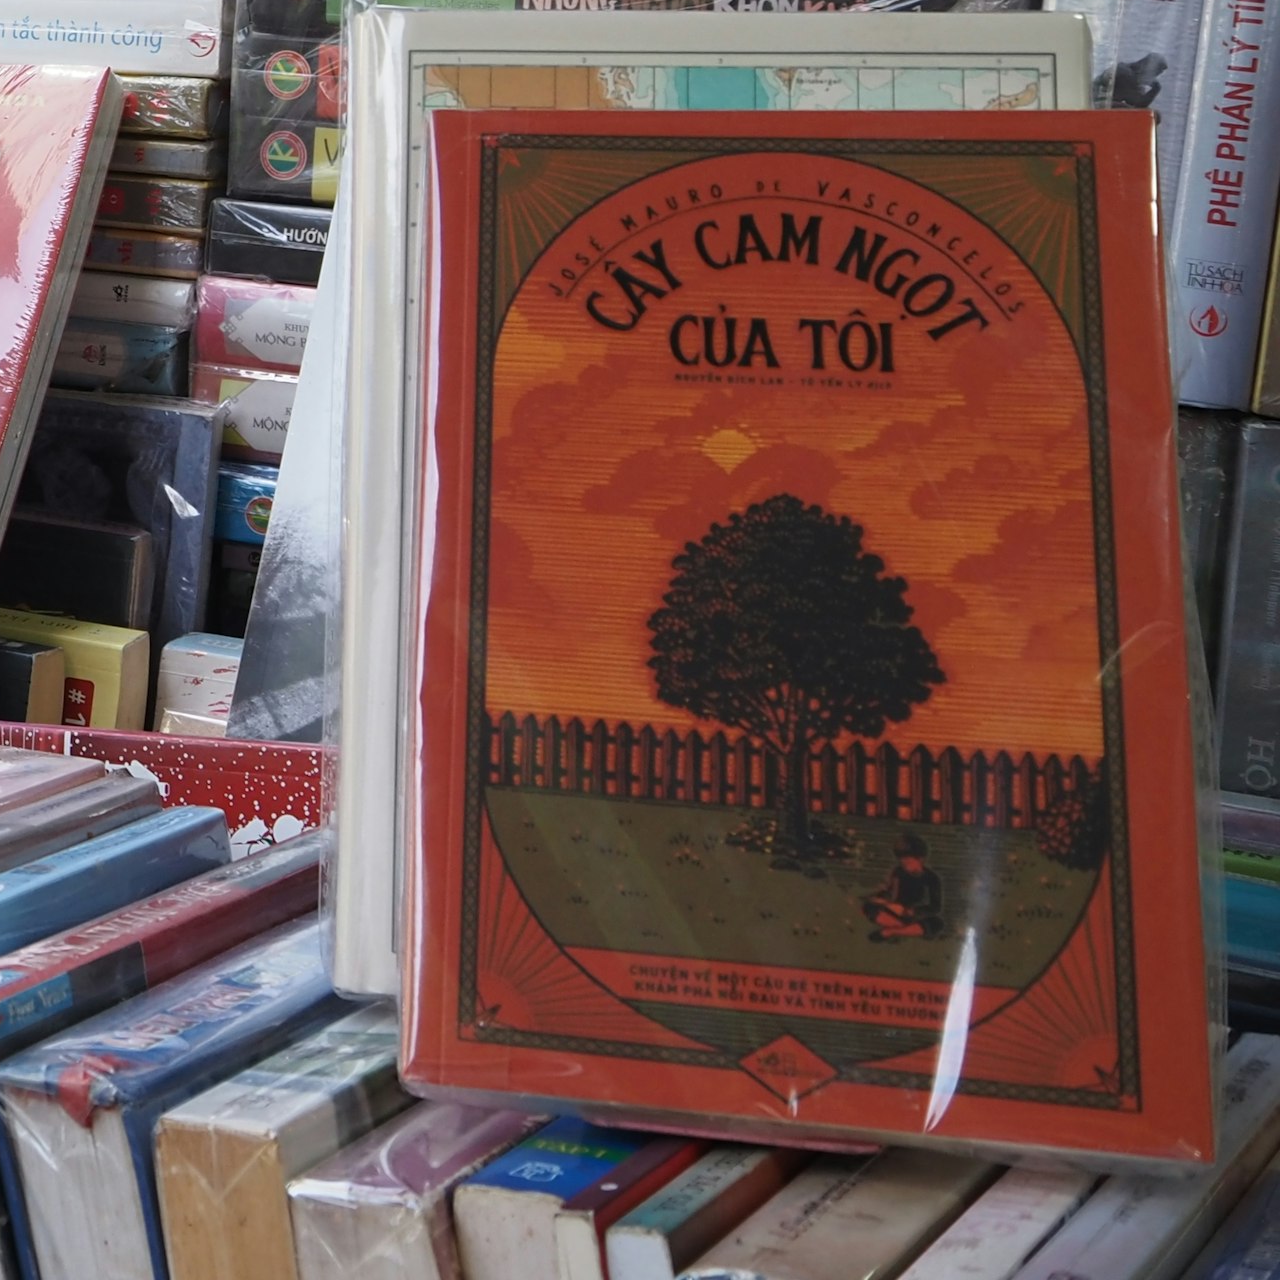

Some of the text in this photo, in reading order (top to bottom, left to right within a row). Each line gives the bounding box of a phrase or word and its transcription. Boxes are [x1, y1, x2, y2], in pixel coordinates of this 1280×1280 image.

[8, 18, 43, 42] tắc
[45, 21, 106, 46] thành
[109, 27, 164, 54] công
[1225, 39, 1260, 97] LÝ
[1213, 103, 1254, 165] PHÁN
[1205, 168, 1245, 229] PHÊ
[548, 180, 1027, 316] JOSÉ MAURO DE VASCONCELOS
[584, 212, 991, 342] CÂY CAM NGỌT
[668, 302, 896, 373] CỦA TÔI
